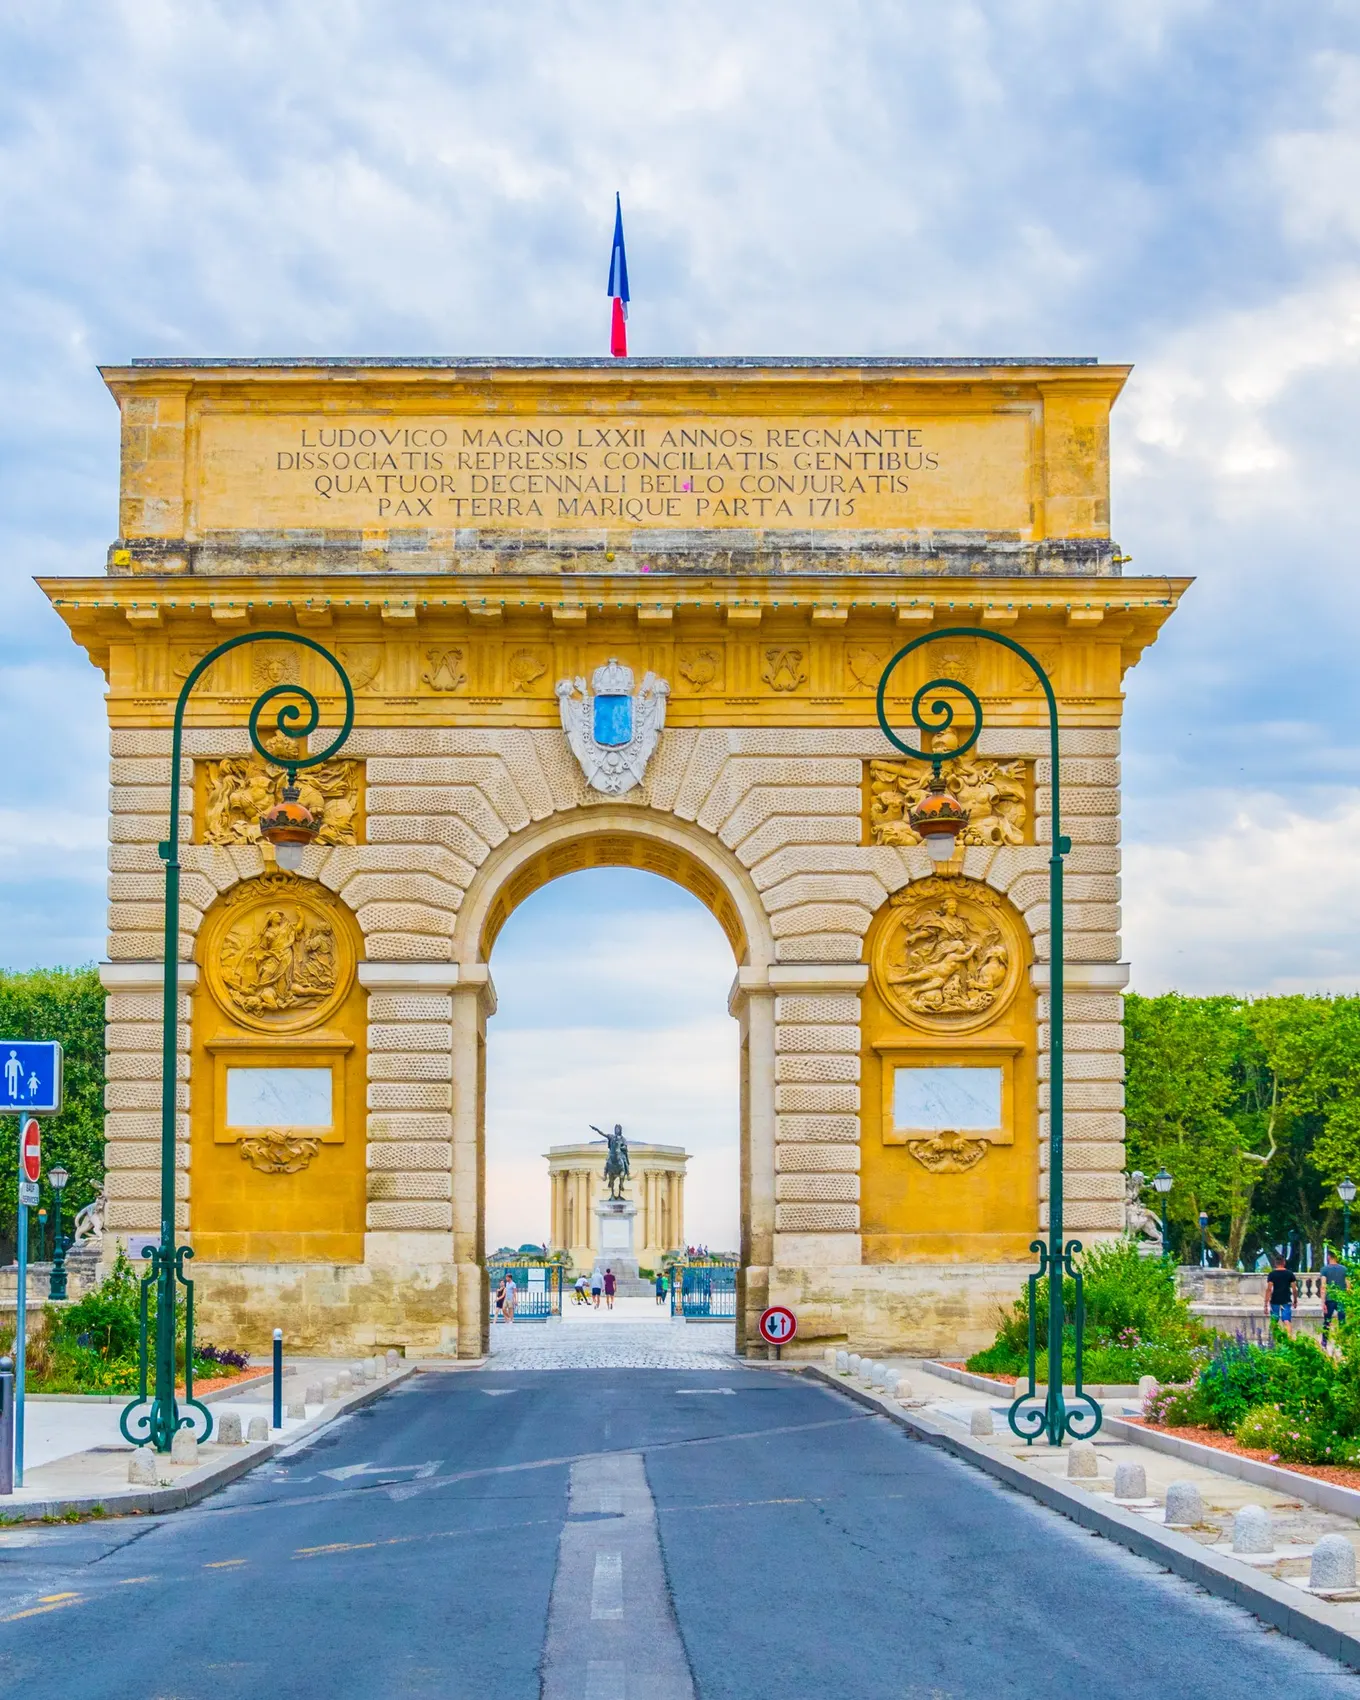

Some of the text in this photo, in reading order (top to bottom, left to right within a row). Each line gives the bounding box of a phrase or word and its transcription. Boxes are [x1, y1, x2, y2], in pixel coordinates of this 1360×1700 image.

[301, 428, 923, 448] LUDOVICO MAGNO LXXII ANNOS REGNANTE
[276, 451, 939, 471] DISSOCIATIS REPRESSIS CONCILIATIS GENTIBUS
[314, 474, 909, 499] QUATUOR DECENNALI BELLO CONJURATIS
[378, 497, 856, 522] PAX TERRA MARIQUE PARTA 1715
